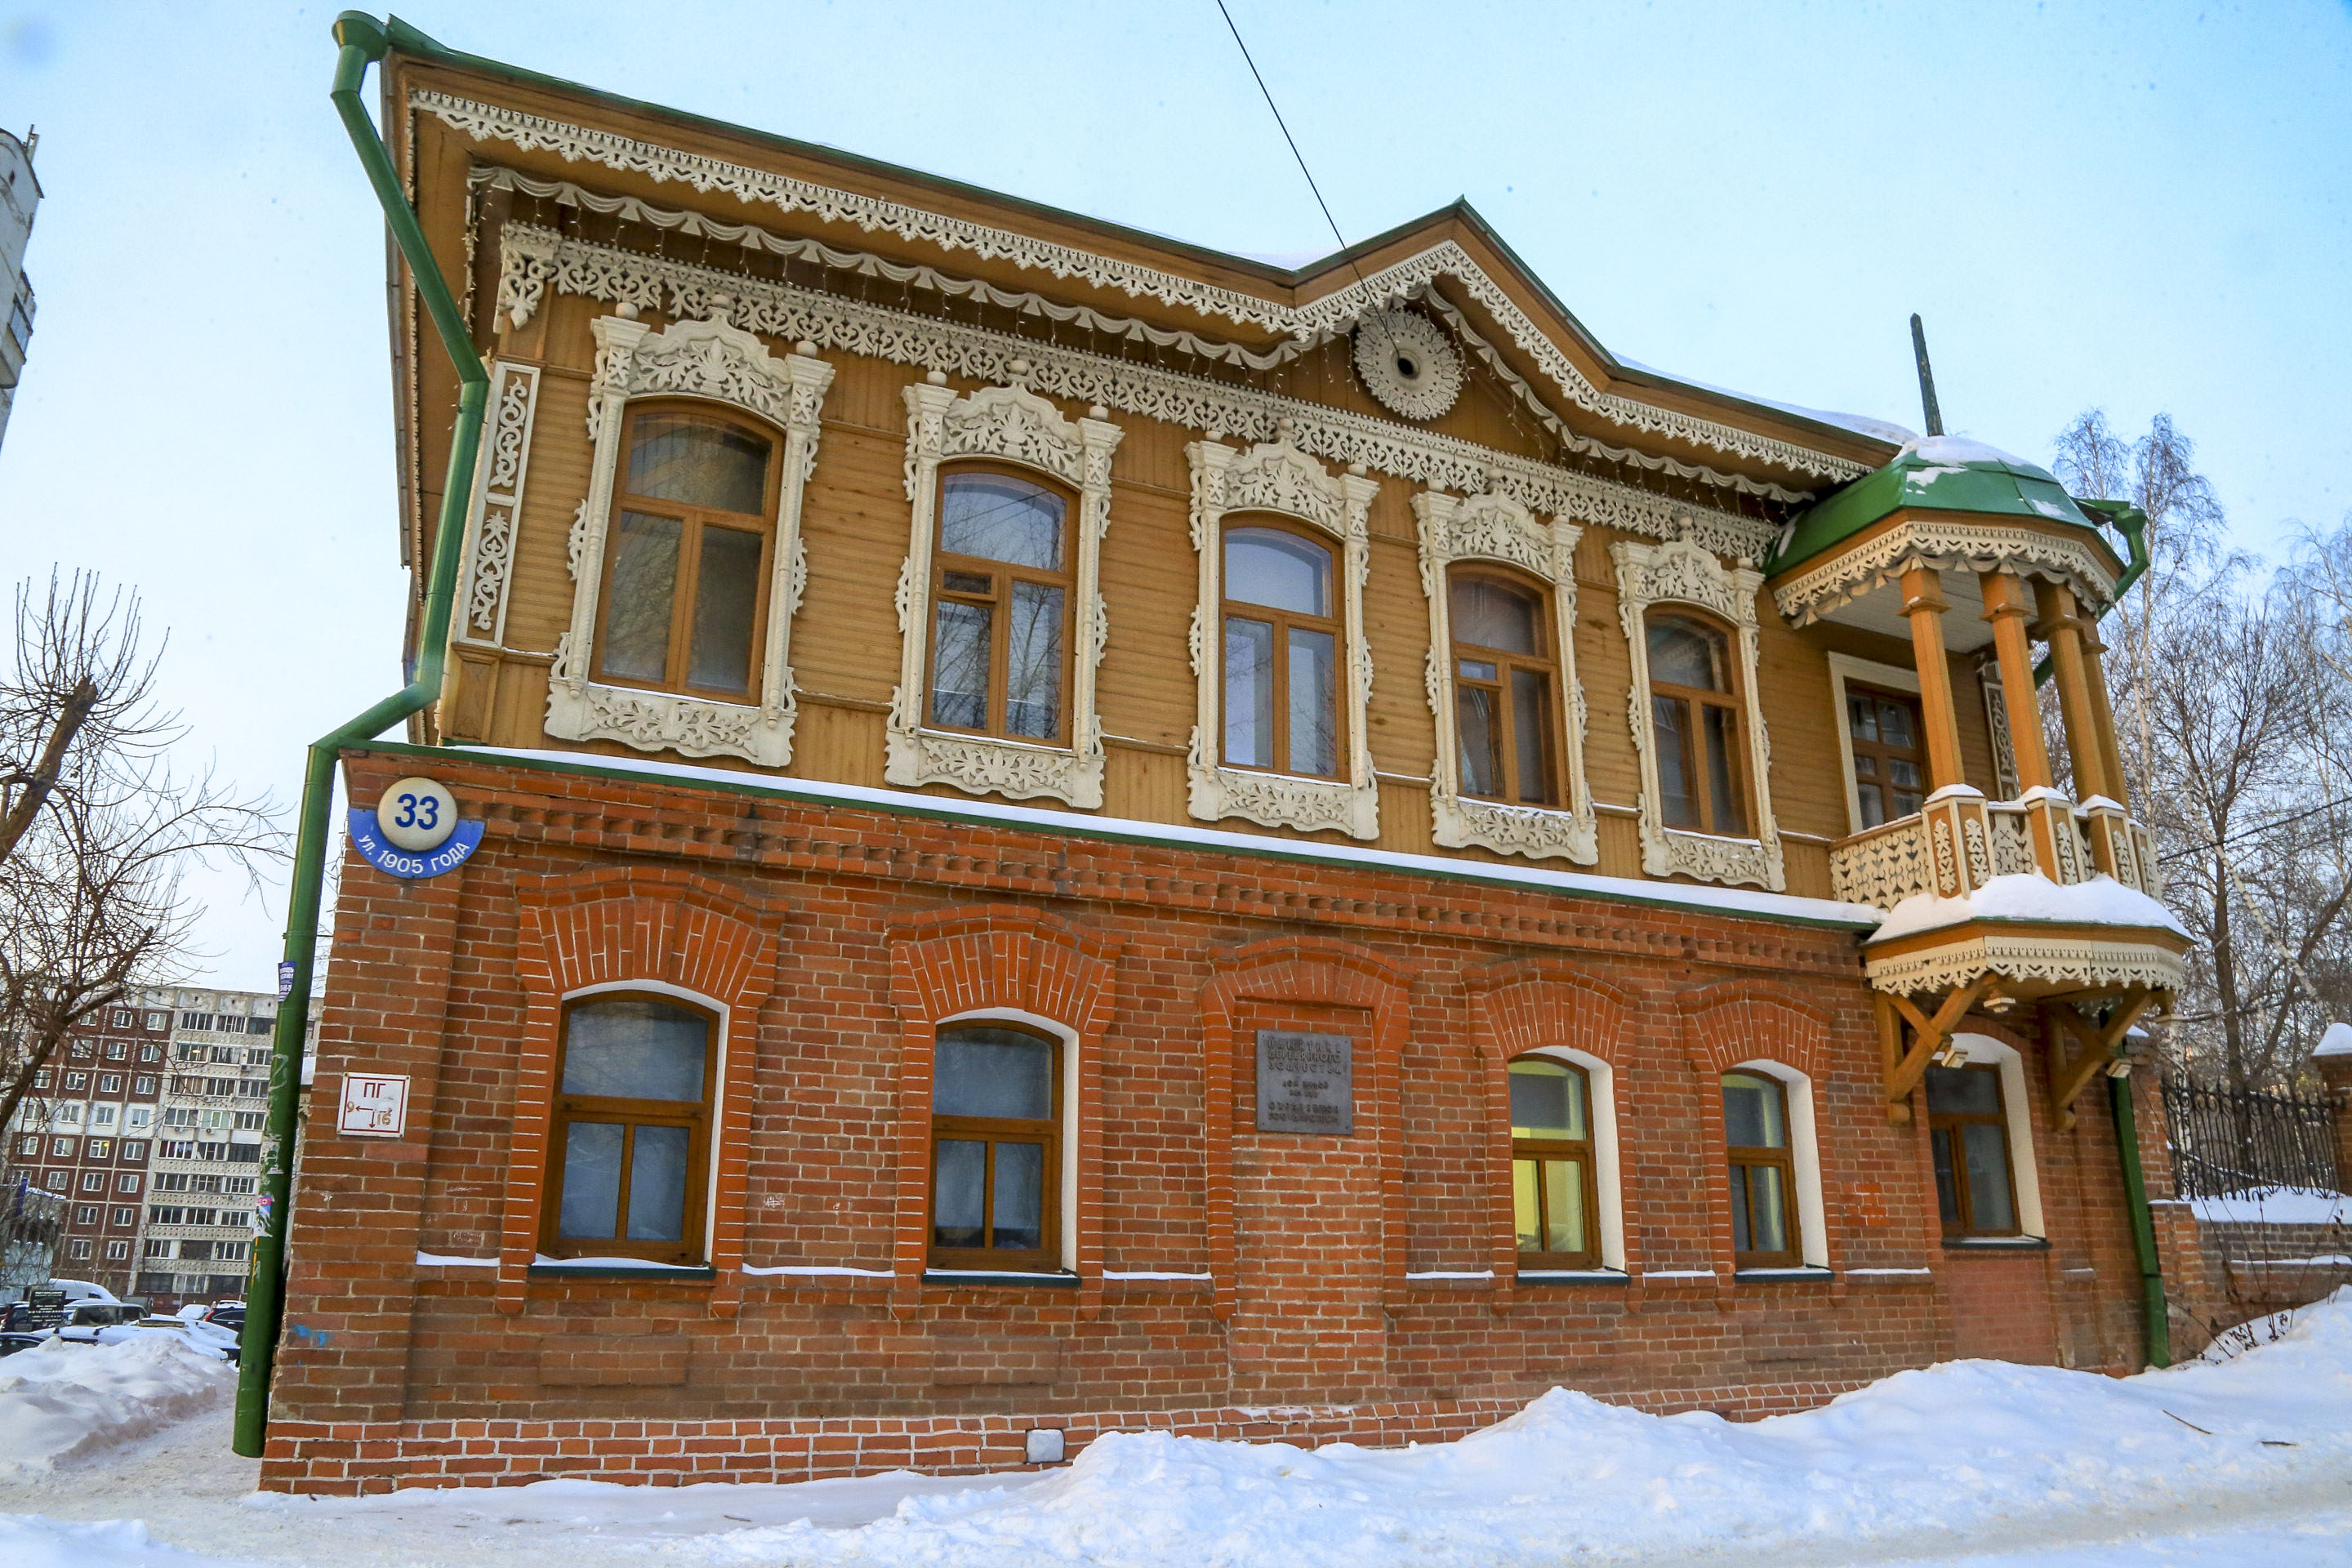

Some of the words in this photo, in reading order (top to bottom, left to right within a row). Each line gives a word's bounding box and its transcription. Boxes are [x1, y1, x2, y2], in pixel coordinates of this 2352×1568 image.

[394, 793, 439, 831] 33
[377, 850, 424, 874] 1905
[430, 842, 470, 871] ГОДА
[363, 1082, 386, 1098] ПГ
